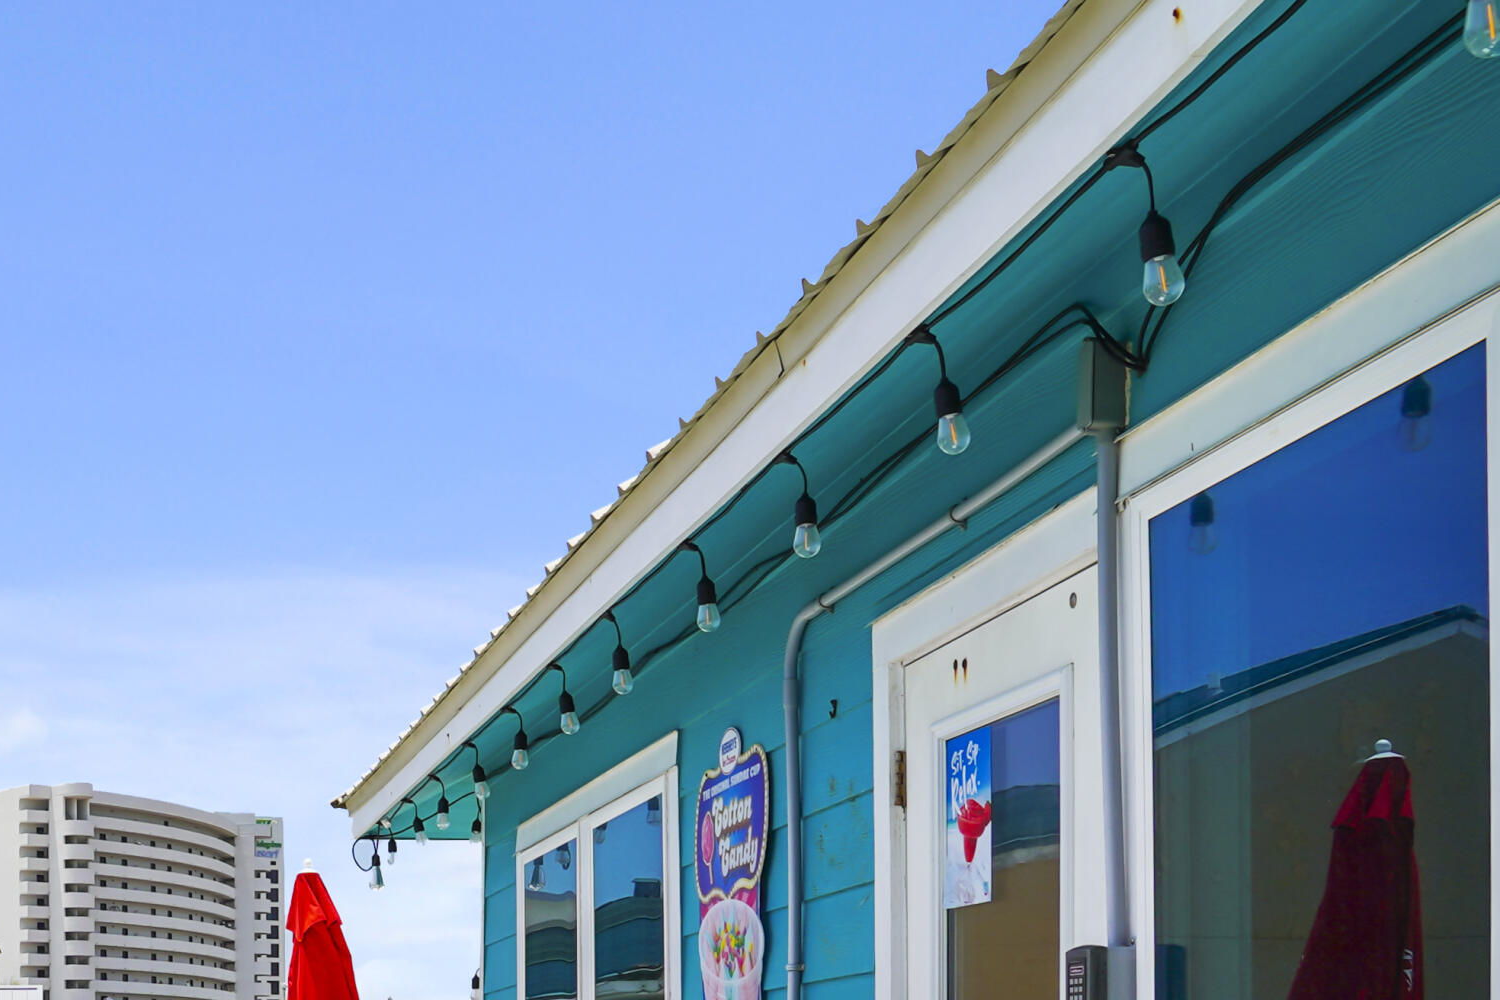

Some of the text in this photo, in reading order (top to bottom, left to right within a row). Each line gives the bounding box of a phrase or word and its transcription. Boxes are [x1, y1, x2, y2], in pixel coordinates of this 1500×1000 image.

[750, 763, 761, 778] CUP
[712, 795, 752, 838] Cotton
[719, 825, 758, 877] Candy
